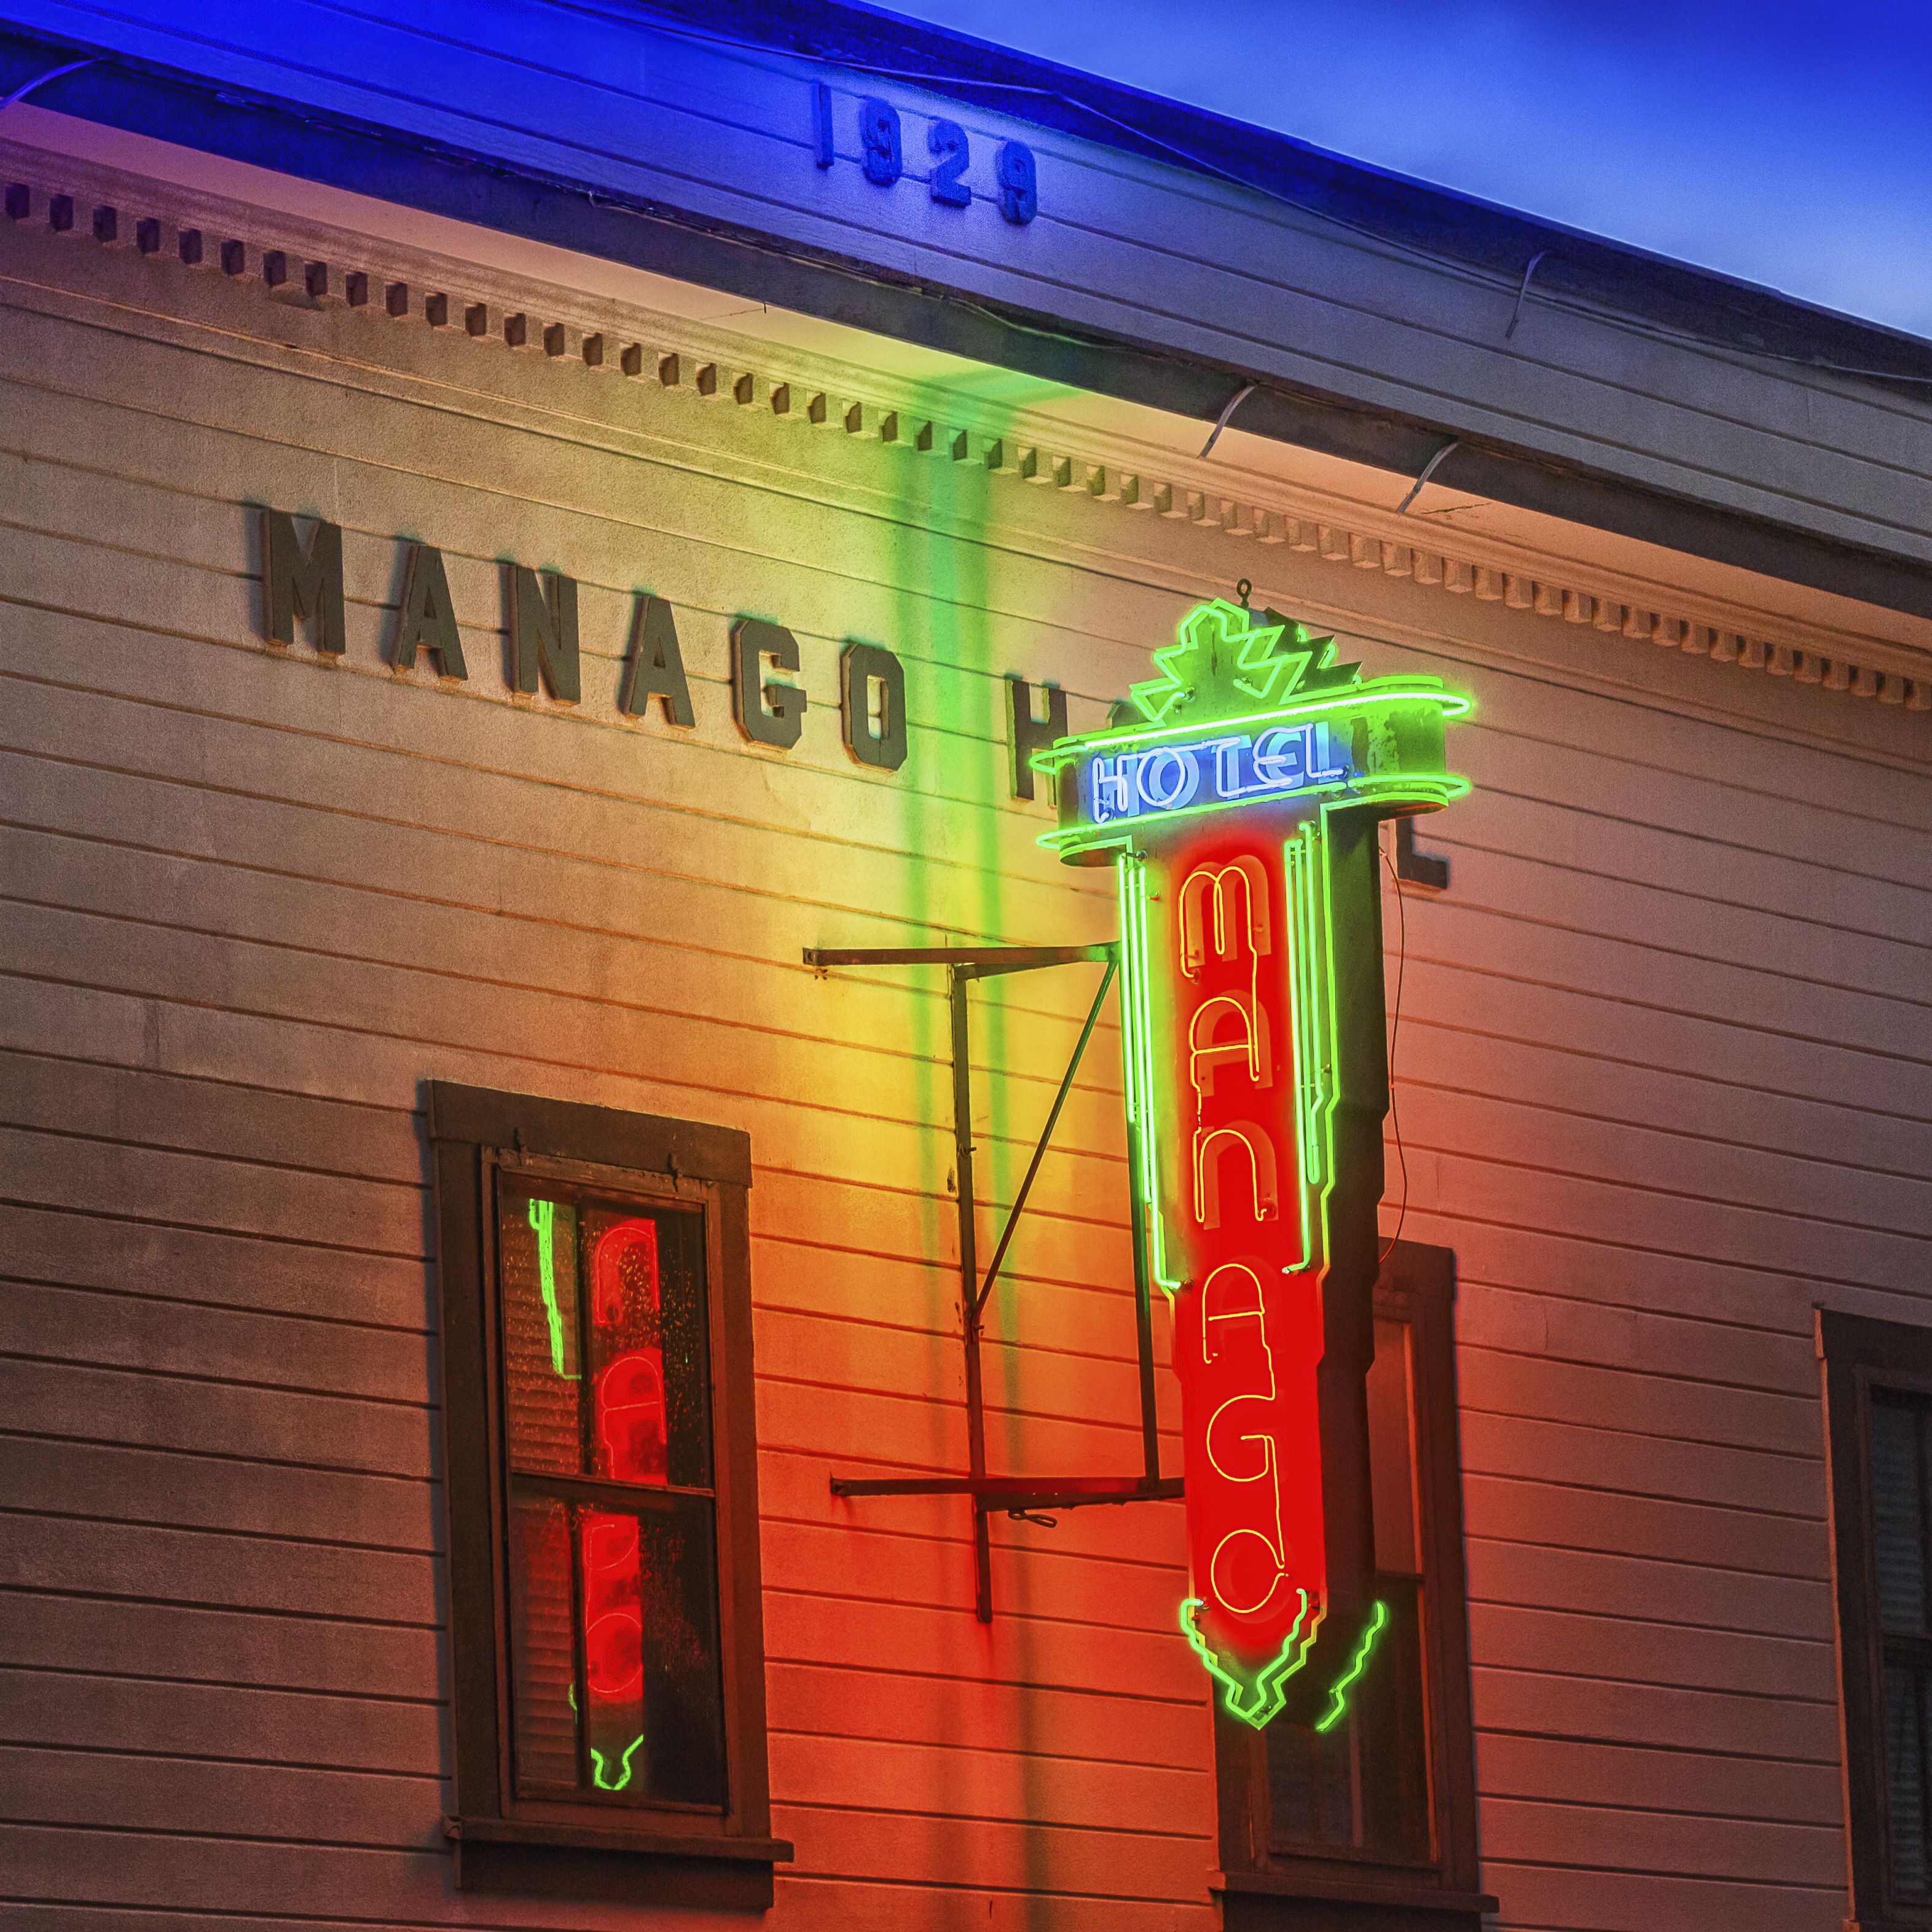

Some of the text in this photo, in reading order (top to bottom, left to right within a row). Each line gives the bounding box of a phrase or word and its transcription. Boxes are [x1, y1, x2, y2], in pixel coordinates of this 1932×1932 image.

[812, 79, 1037, 226] 1929
[261, 509, 908, 773] MANAGO
[1091, 721, 1346, 825] HOTEL
[1179, 854, 1289, 1623] MANAGO
